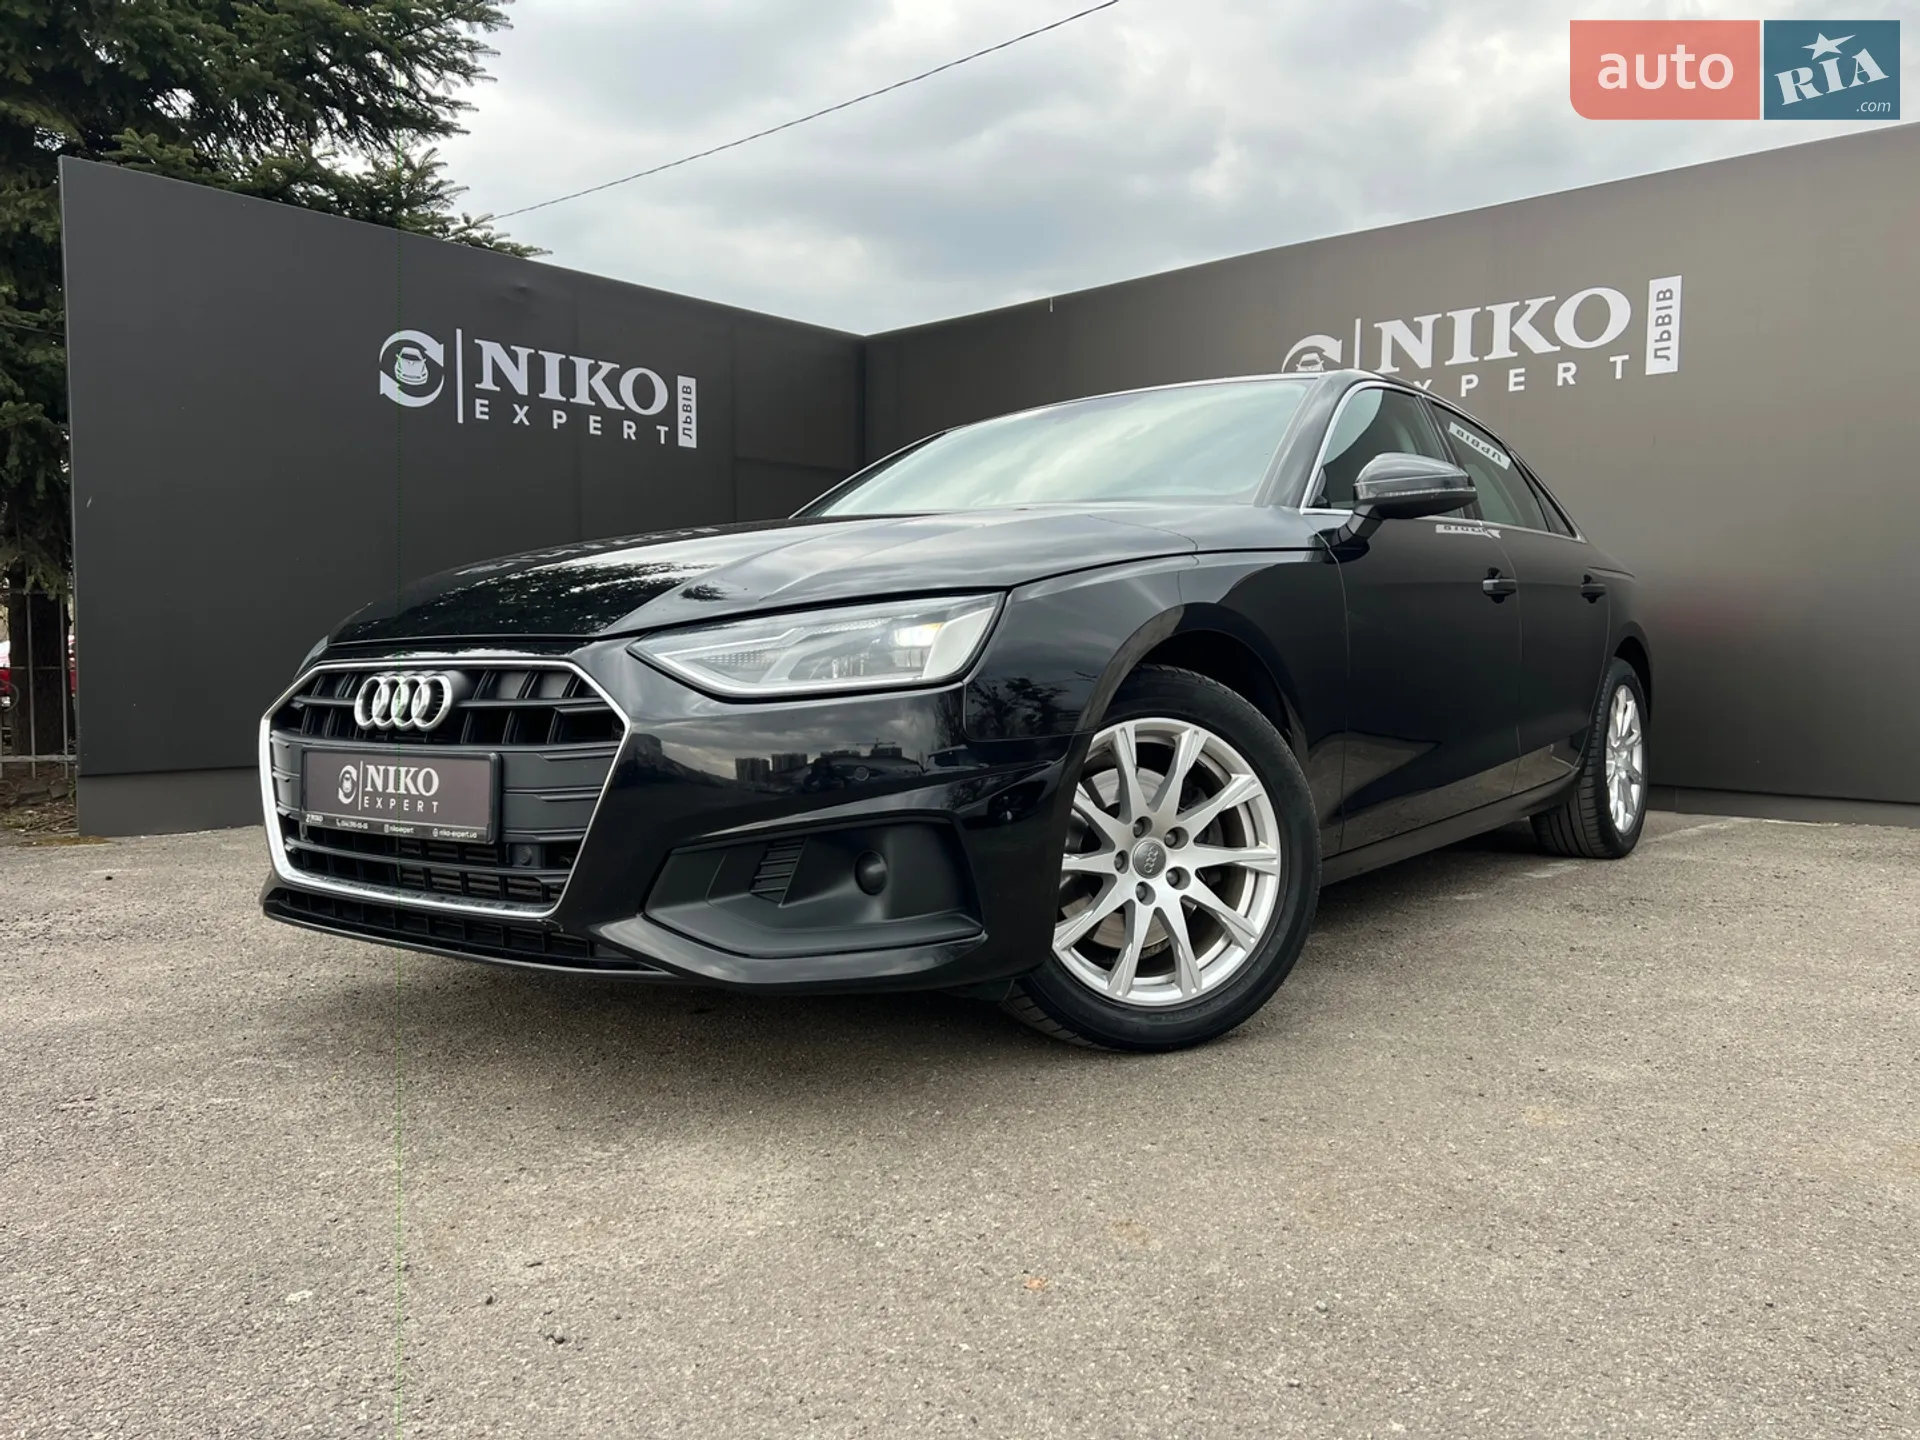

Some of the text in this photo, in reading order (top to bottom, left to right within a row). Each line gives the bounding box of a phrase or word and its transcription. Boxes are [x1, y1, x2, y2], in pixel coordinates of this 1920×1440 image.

[1373, 287, 1631, 373] NIKO
[1653, 288, 1674, 362] ЛЬВІВ
[474, 338, 669, 416] NIKO
[475, 398, 669, 444] EXPERT
[682, 385, 693, 439] ЛЬВІВ
[363, 796, 439, 813] EXPERT
[364, 764, 440, 797] NIKO
